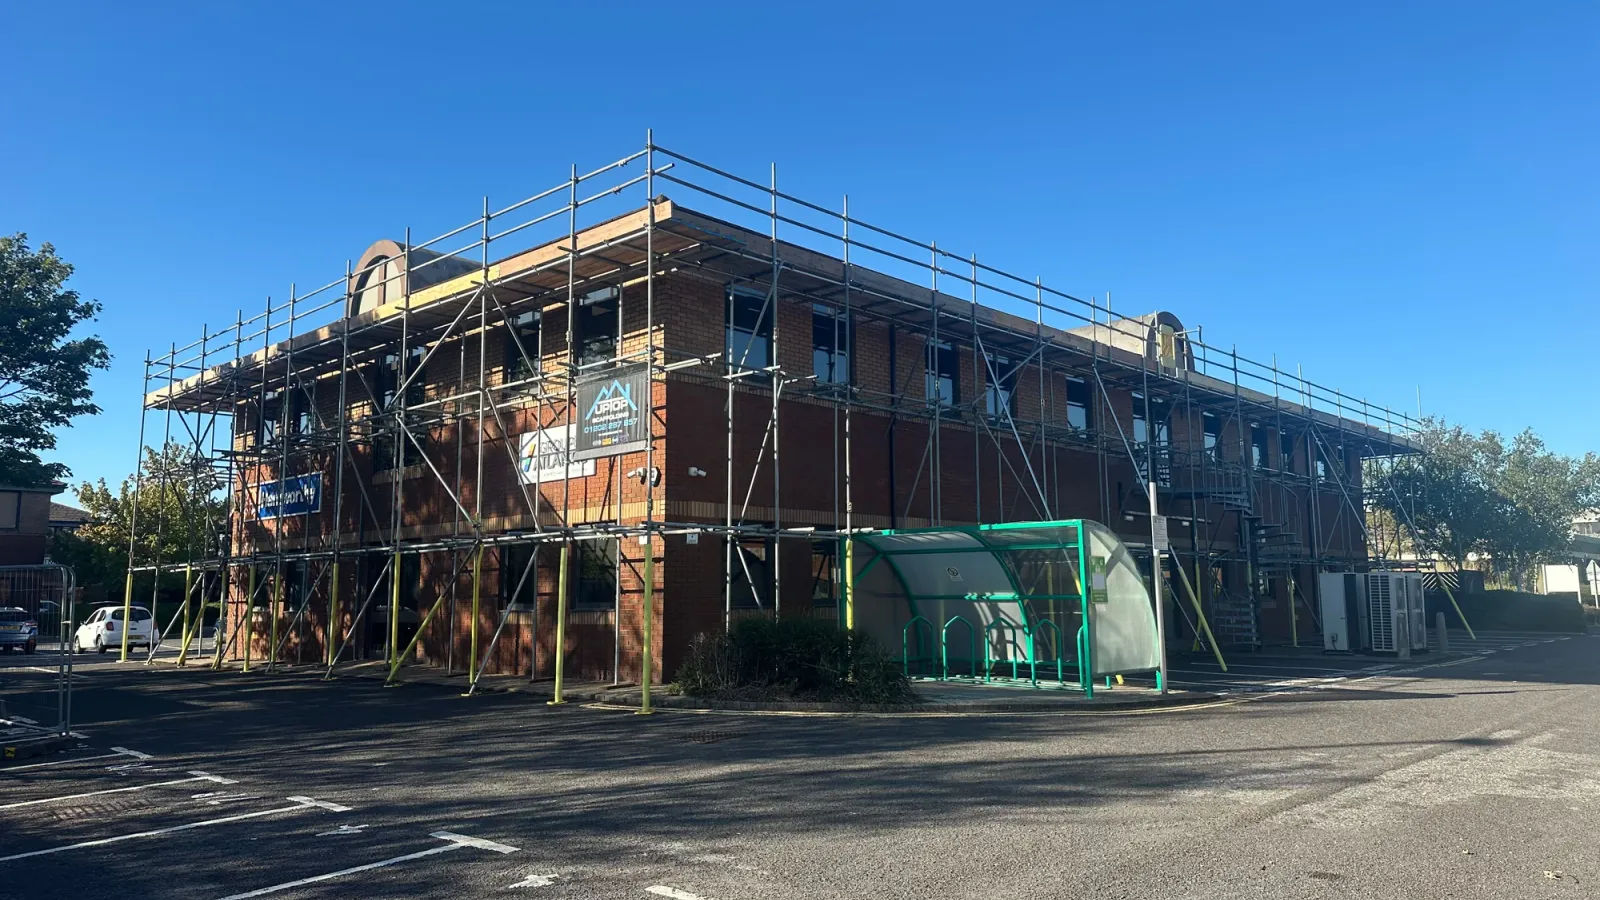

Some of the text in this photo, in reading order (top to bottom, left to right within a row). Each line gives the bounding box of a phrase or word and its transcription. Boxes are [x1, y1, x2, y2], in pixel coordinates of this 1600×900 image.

[595, 397, 628, 415] UPTOP
[592, 411, 629, 423] SCAFFOLDING
[584, 424, 607, 434] 01202
